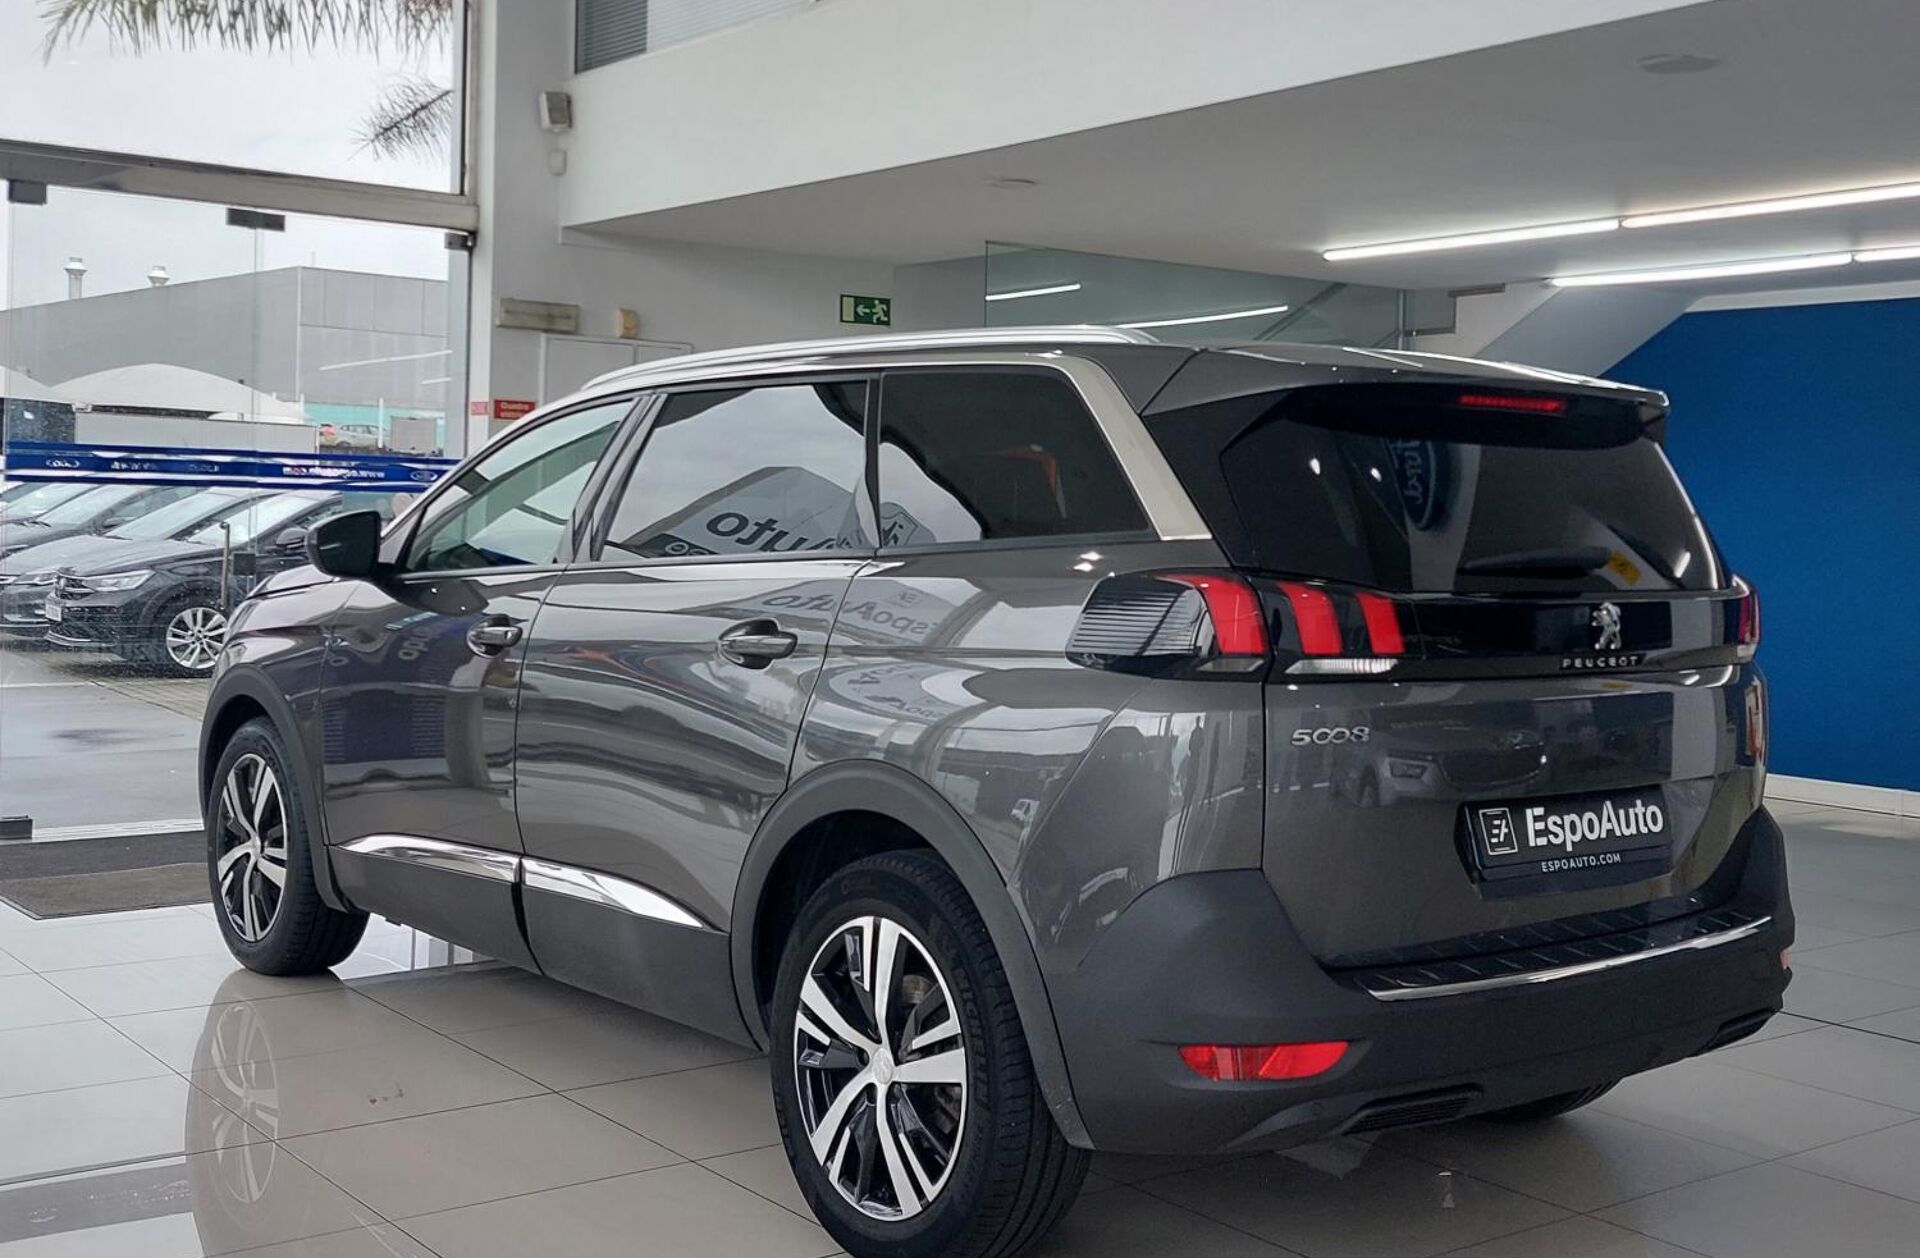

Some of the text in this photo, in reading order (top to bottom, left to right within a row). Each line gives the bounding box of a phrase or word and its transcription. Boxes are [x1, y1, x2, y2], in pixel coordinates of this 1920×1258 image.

[1562, 656, 1639, 668] PEUGEOT
[1291, 726, 1371, 746] 5008
[1524, 799, 1664, 852] EspoAuto
[1541, 853, 1622, 873] ESPOAUTO.COM
